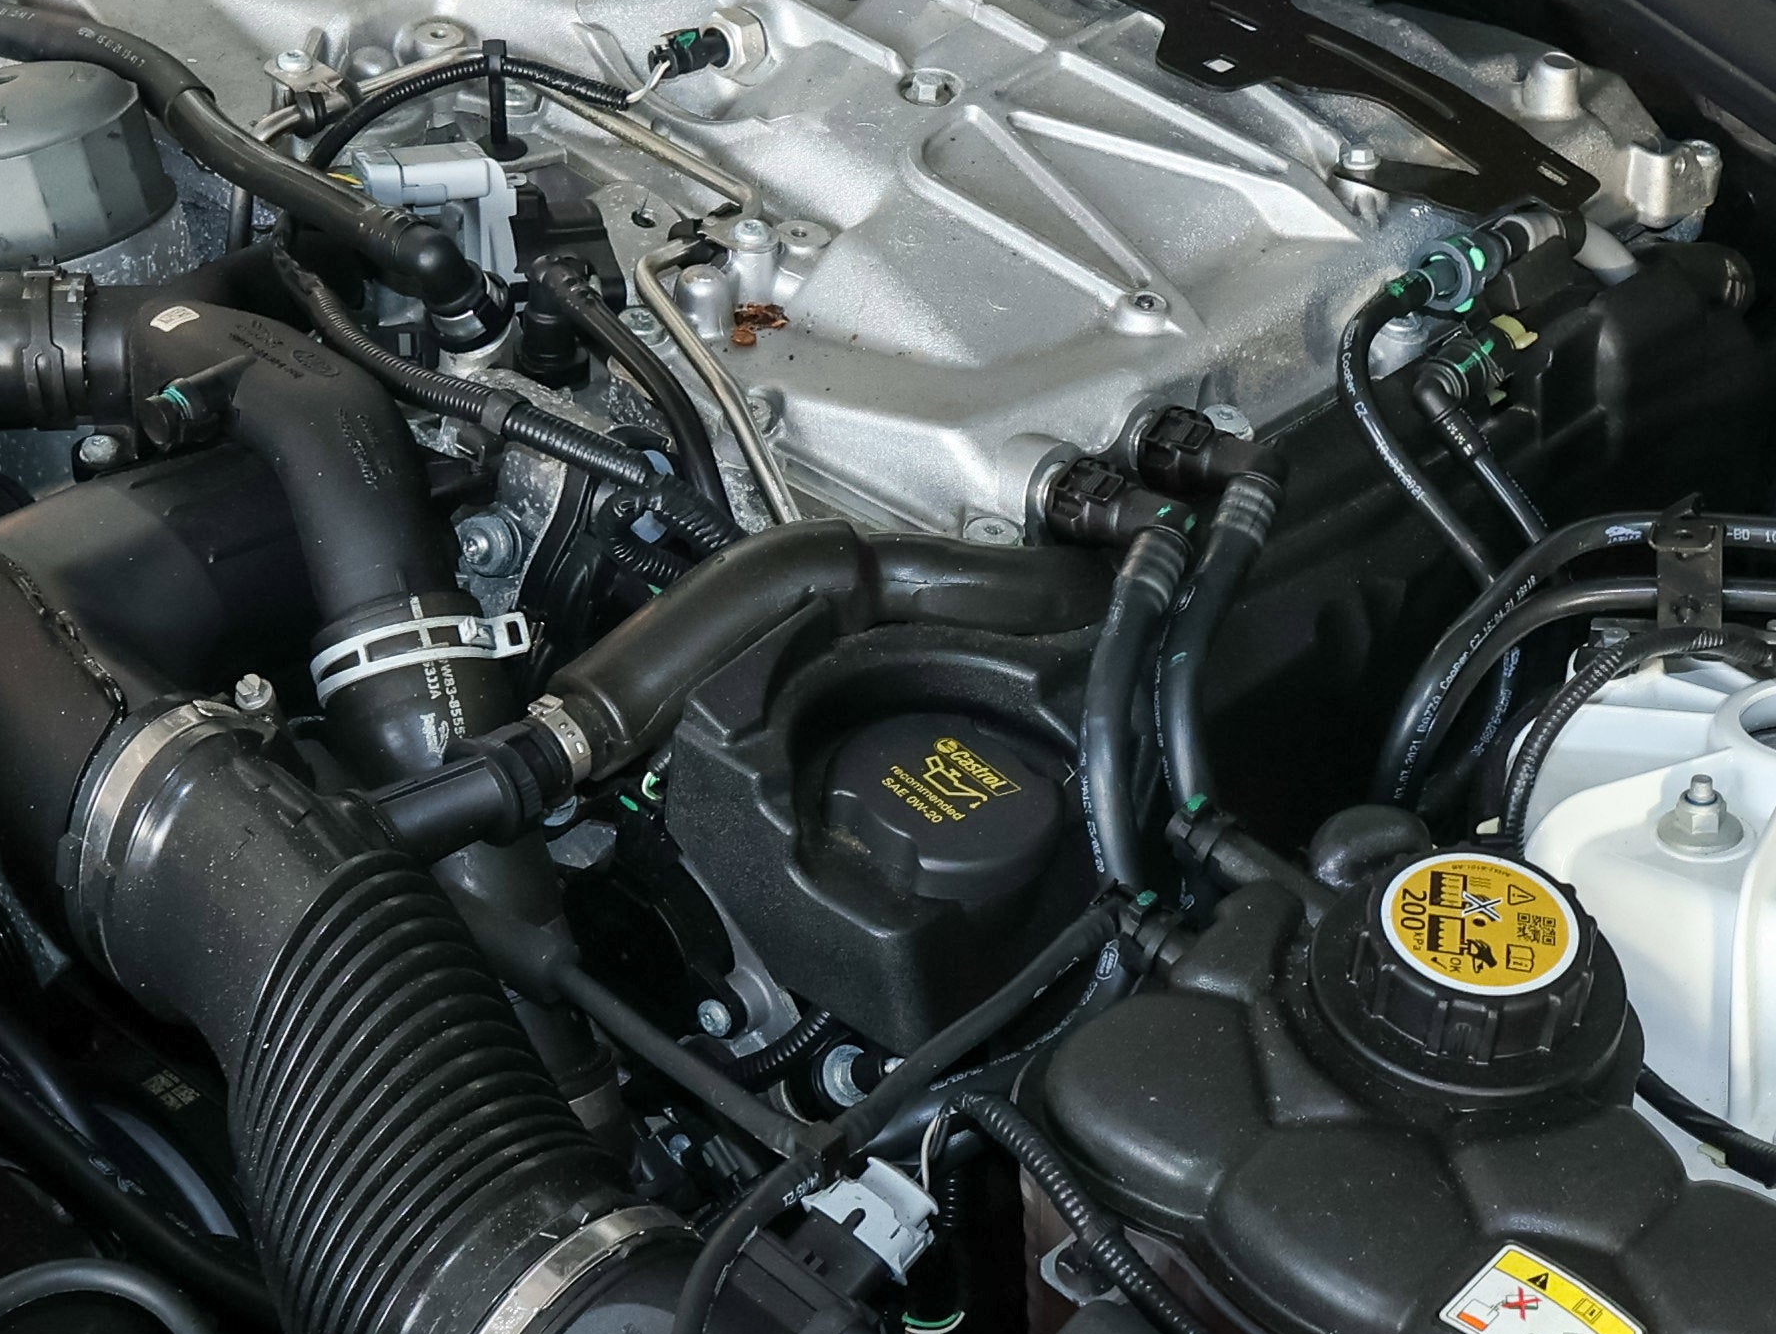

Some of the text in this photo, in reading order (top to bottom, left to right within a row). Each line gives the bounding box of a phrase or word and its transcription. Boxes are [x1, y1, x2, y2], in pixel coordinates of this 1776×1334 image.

[889, 764, 966, 822] recommended
[949, 749, 1003, 790] Castrol
[881, 776, 944, 824] SAE 0W-20
[1400, 887, 1428, 952] 200 kPa
[1450, 957, 1462, 974] OK
